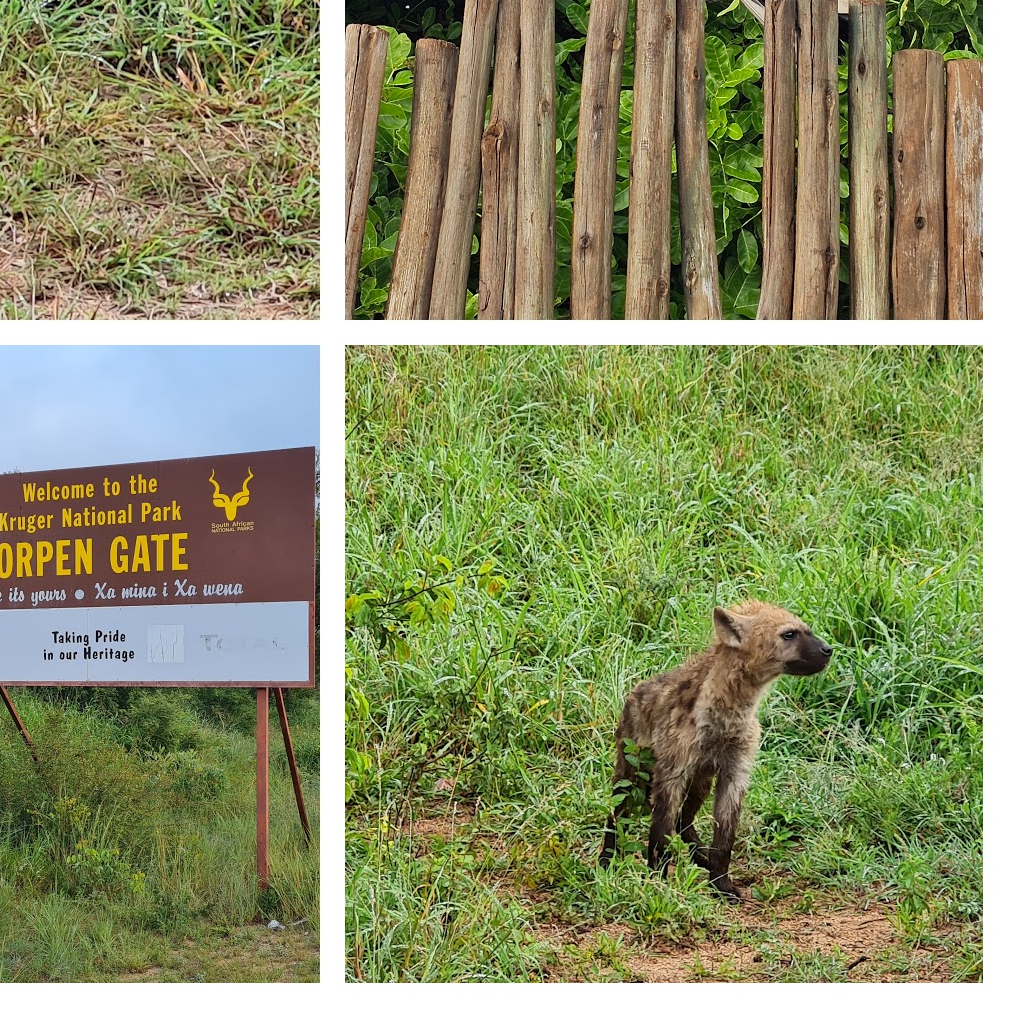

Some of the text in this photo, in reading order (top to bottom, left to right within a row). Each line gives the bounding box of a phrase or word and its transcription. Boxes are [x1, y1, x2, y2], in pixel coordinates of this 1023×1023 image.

[23, 474, 158, 502] Welcome to the
[0, 500, 182, 533] Kruger National Park
[110, 532, 189, 574] GATE
[9, 587, 25, 602] its
[31, 588, 67, 606] yours
[94, 581, 116, 599] Xa
[121, 583, 157, 599] mina
[162, 581, 169, 597] i
[174, 579, 197, 597] Xa
[203, 582, 244, 596] wena
[51, 629, 126, 646] Taking Pride
[43, 646, 135, 663] in our Heritage
